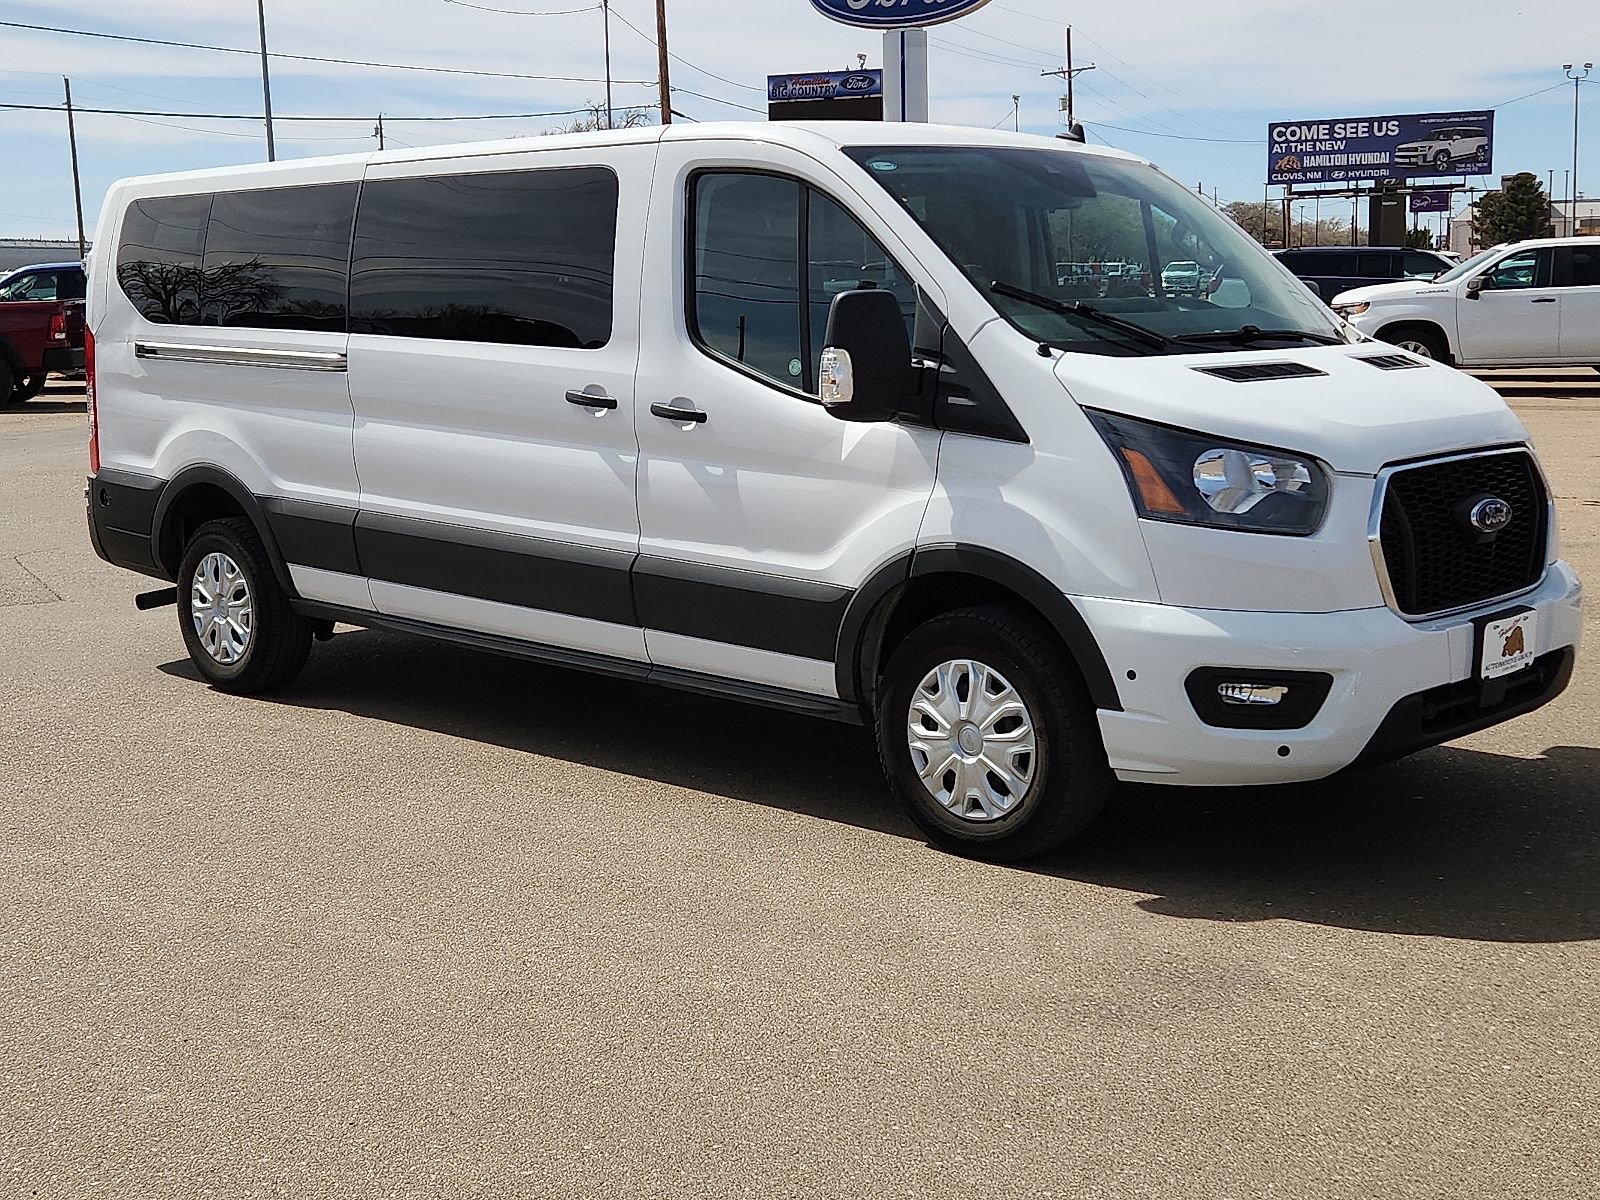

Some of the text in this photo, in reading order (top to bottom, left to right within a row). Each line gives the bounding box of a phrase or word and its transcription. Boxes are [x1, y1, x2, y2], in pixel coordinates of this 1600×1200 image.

[846, 76, 870, 89] Ford
[771, 84, 838, 98] BIG COUNTRY
[1272, 120, 1400, 142] COME SEE US
[1271, 140, 1347, 154] AT THE NEW
[1303, 151, 1390, 168] HAMILTON HYUNDAI
[1271, 171, 1322, 181] CLOVIS, NM
[1348, 168, 1390, 178] HYUNDAI
[1485, 503, 1508, 525] Ford
